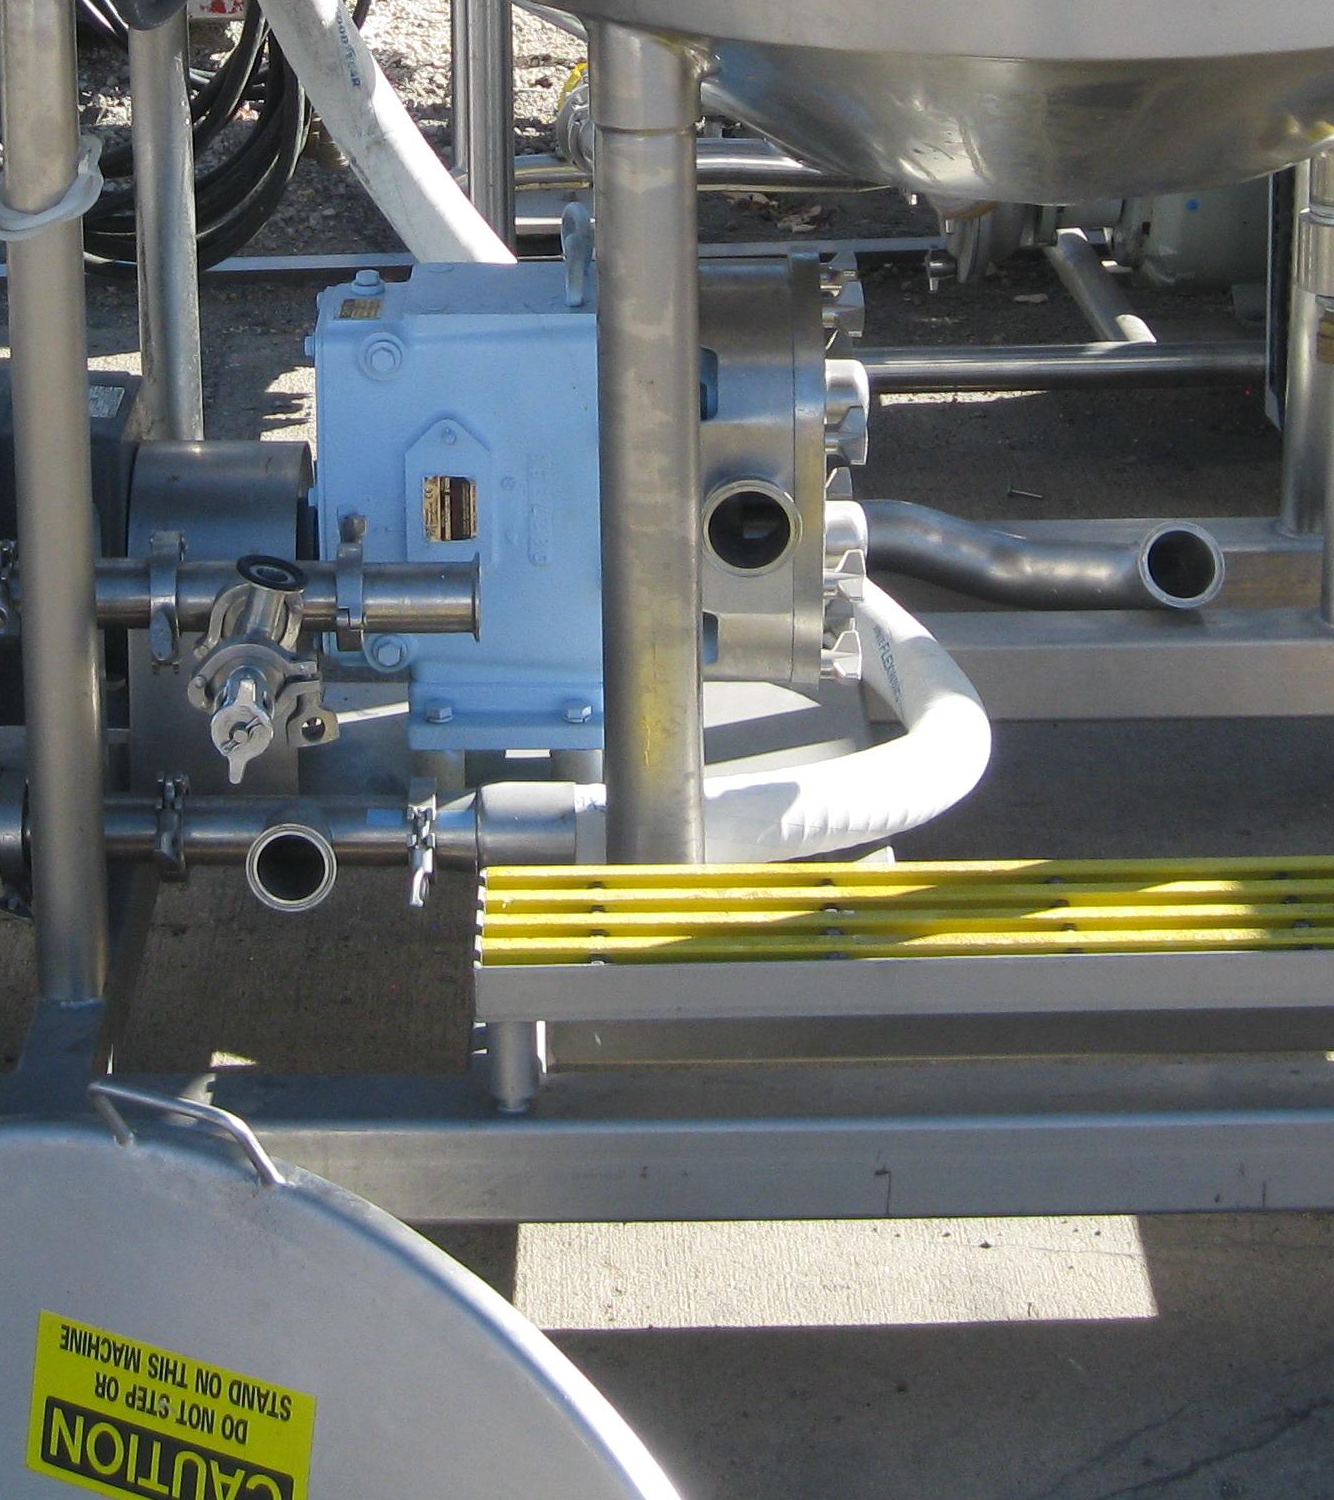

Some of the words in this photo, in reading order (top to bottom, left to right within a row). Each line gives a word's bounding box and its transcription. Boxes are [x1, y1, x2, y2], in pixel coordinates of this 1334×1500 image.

[59, 1324, 142, 1374] MACHINE
[94, 1372, 118, 1402] OR
[147, 1352, 188, 1389] THIS
[195, 1368, 222, 1399] ON
[125, 1383, 171, 1420] STEP
[175, 1400, 215, 1434] NOT
[228, 1379, 293, 1421] STAND
[221, 1413, 249, 1445] DO
